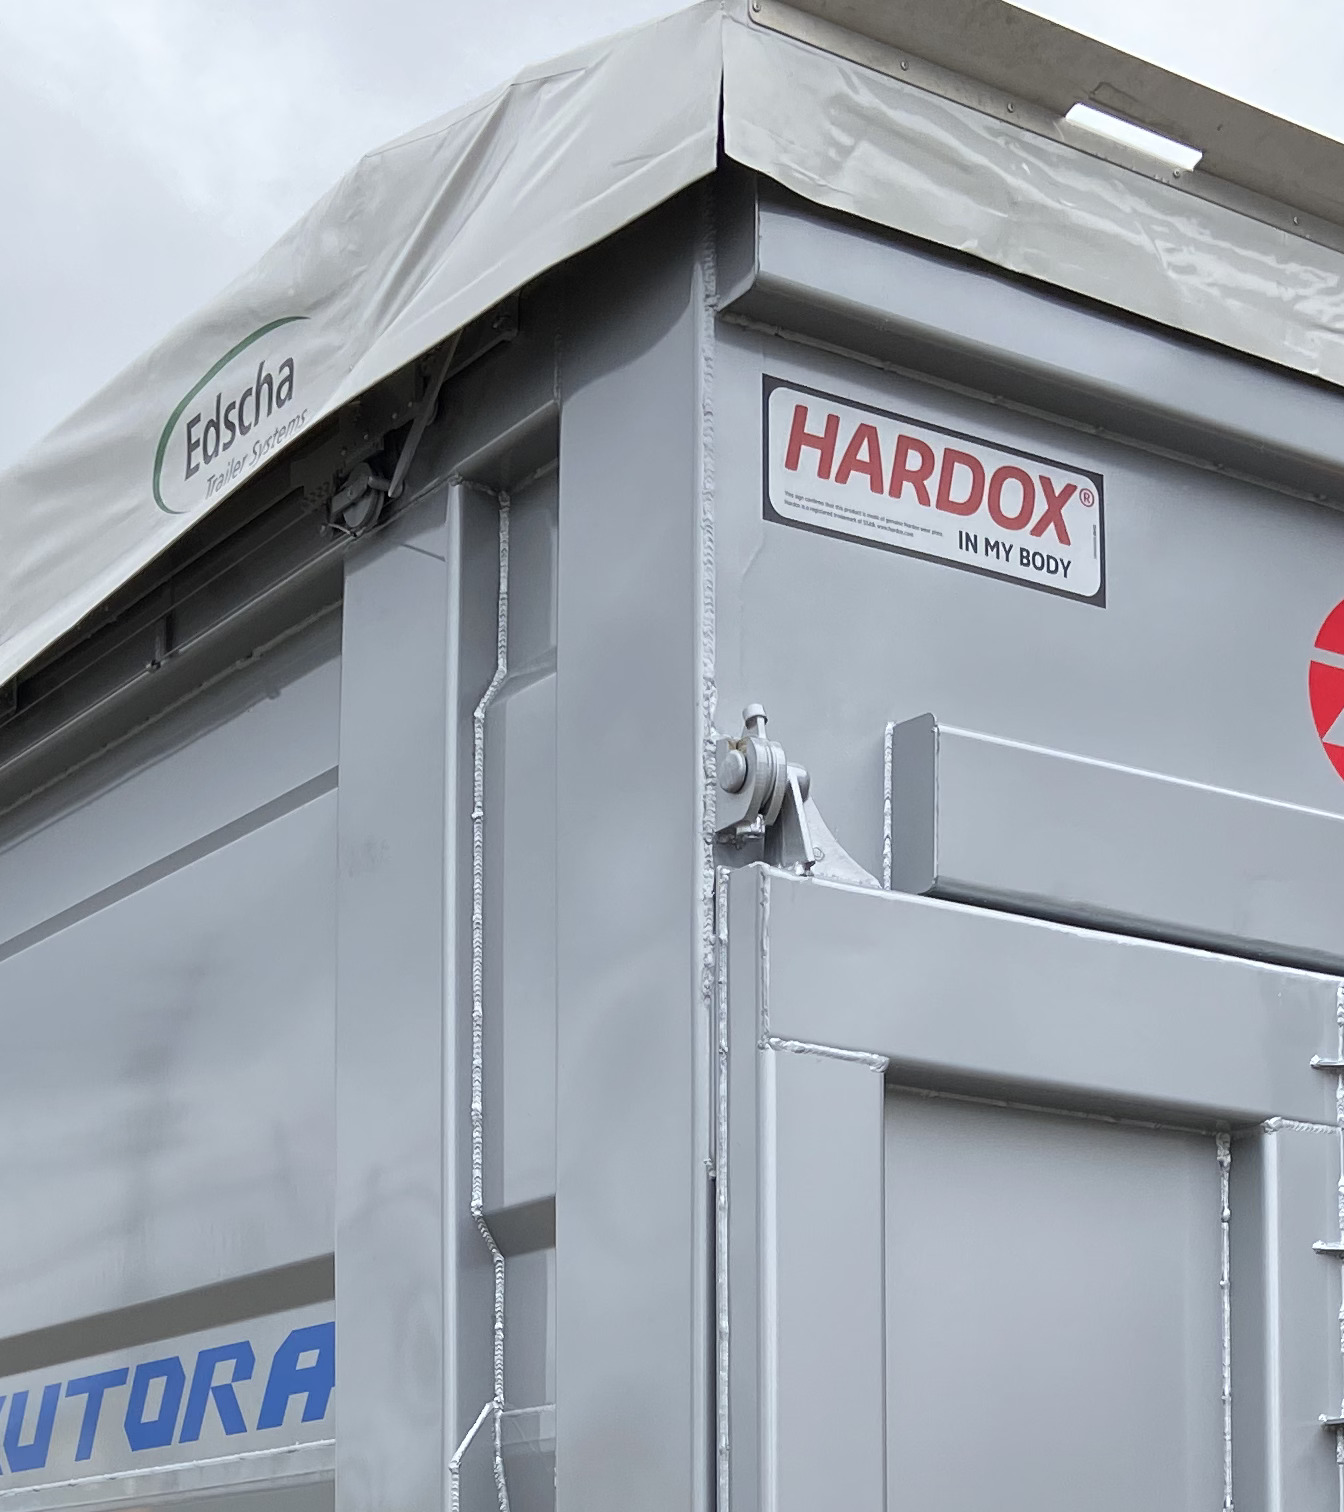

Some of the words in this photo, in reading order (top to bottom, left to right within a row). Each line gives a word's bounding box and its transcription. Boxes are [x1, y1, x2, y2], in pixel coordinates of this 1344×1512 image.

[184, 357, 294, 482] Edscha
[205, 453, 248, 500] Trailer
[249, 408, 308, 467] Systems
[959, 530, 977, 554] IN
[984, 537, 1014, 562] MY
[1019, 547, 1071, 578] BODY
